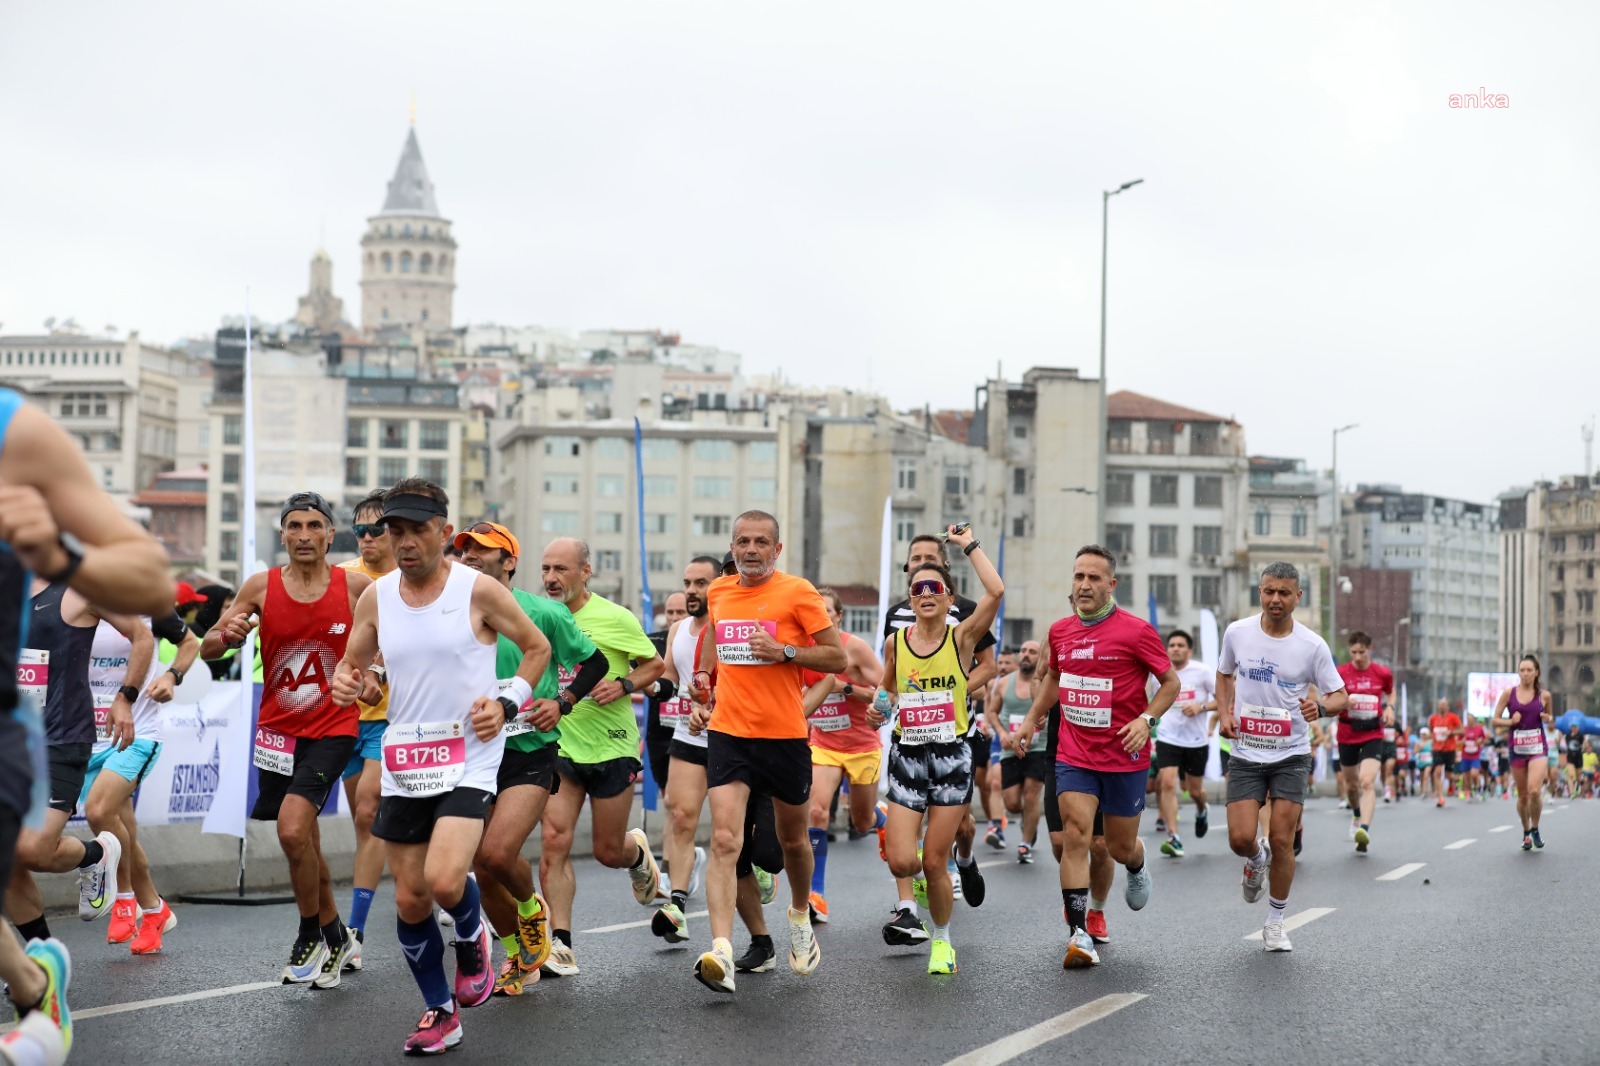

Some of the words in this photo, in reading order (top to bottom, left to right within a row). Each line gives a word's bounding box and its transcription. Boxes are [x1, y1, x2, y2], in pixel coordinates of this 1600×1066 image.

[92, 657, 129, 668] TEMP
[17, 667, 36, 682] 20
[919, 675, 957, 690] TRIA
[916, 708, 946, 722] 1275
[1256, 722, 1282, 734] 1120
[264, 732, 286, 749] 518
[410, 745, 451, 764] 1718
